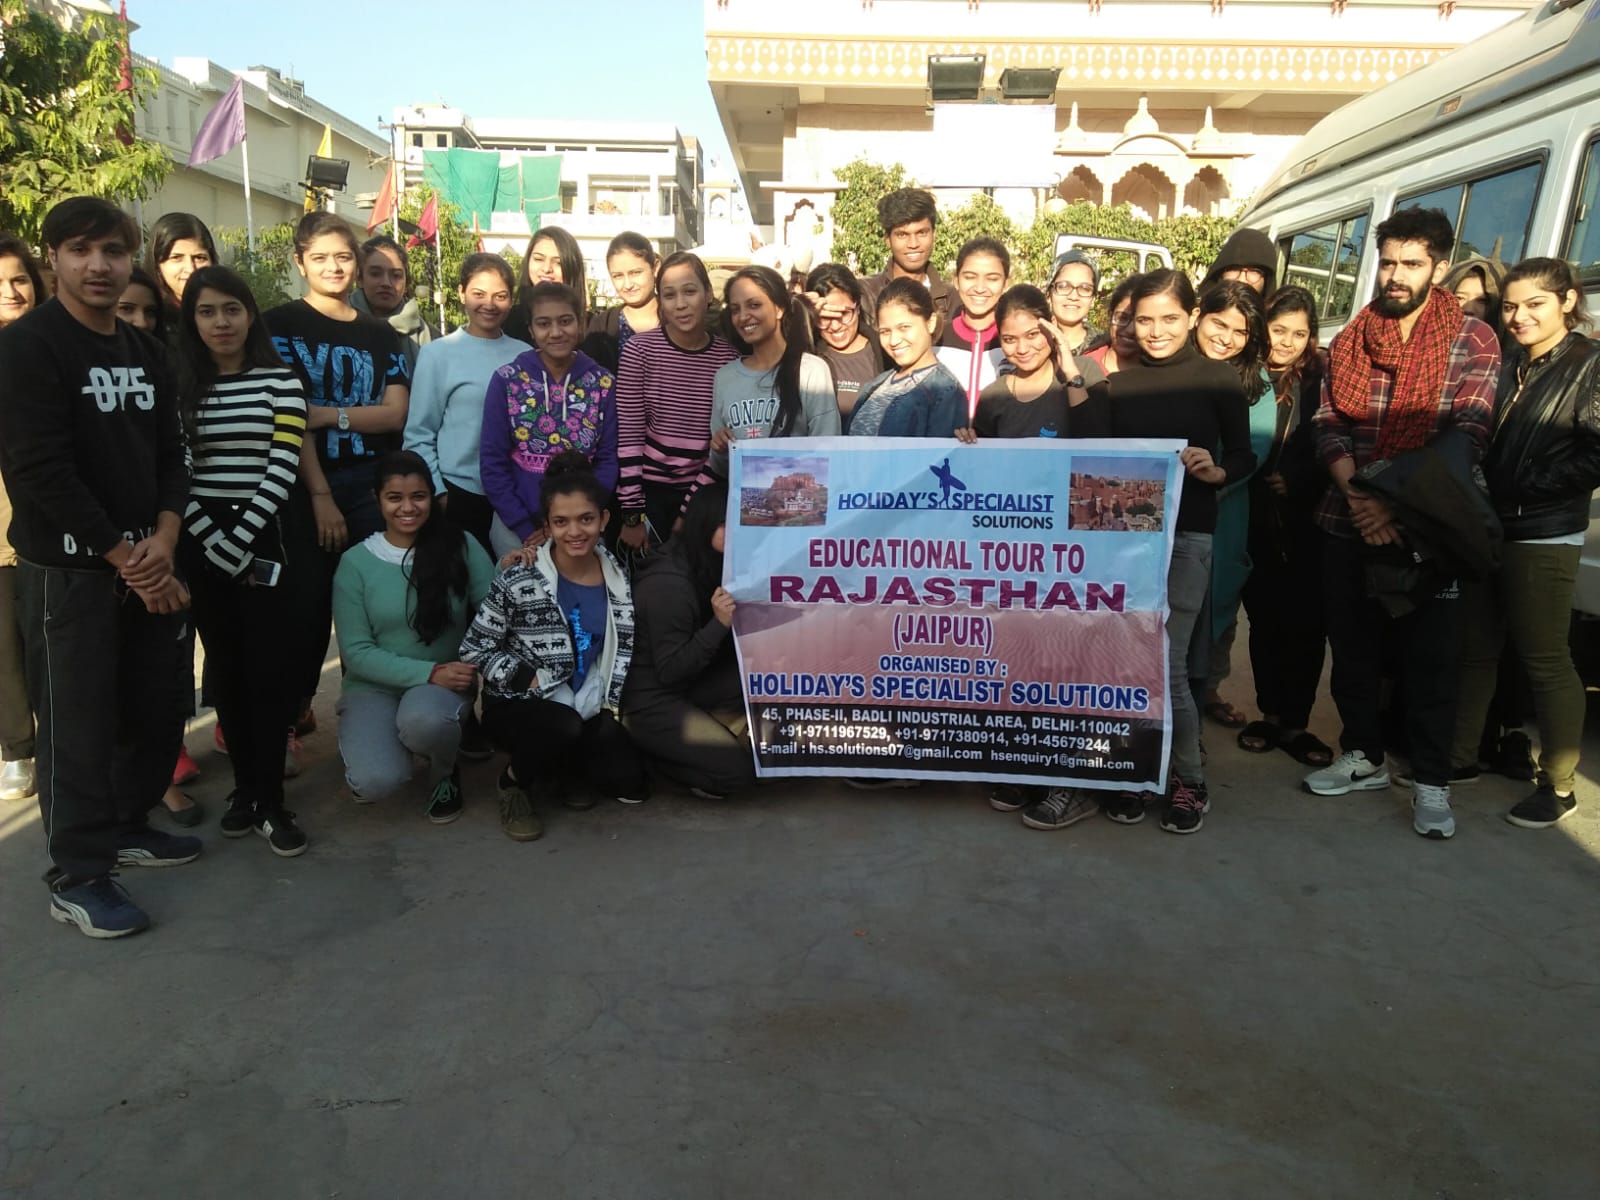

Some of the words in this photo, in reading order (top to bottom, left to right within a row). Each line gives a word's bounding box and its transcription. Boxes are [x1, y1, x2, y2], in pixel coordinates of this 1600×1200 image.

[82, 367, 155, 412] 075
[838, 492, 939, 510] HOLIDAY'S
[951, 492, 1054, 512] SPECIALIST
[972, 514, 1054, 530] SOLUTIONS
[809, 538, 972, 571] EDUCATIONAL
[980, 541, 1045, 573] TOUR
[1052, 543, 1085, 574] TO
[769, 575, 1126, 612] RAJASTHAN
[894, 614, 993, 655] (JAIPUR)
[879, 656, 970, 674] ORGANISED
[750, 674, 865, 697] HOLIDAY'S
[872, 676, 1004, 703] SPECIALIST
[1011, 682, 1149, 711] SOLUTIONS
[762, 708, 782, 722] 45,
[786, 708, 848, 723] PHASE-II,
[852, 709, 892, 723] BADLI
[897, 711, 981, 727] INDUSTRIAL
[985, 715, 1027, 731] AREA,
[1032, 717, 1130, 736] DELHI-110042
[780, 724, 891, 741] +91-9711967529,
[895, 728, 1009, 747] +91-9717380914,
[809, 742, 983, 760] hs.solutions07@gmail.com
[991, 749, 1135, 770] hsenquiry1@gmail.com
